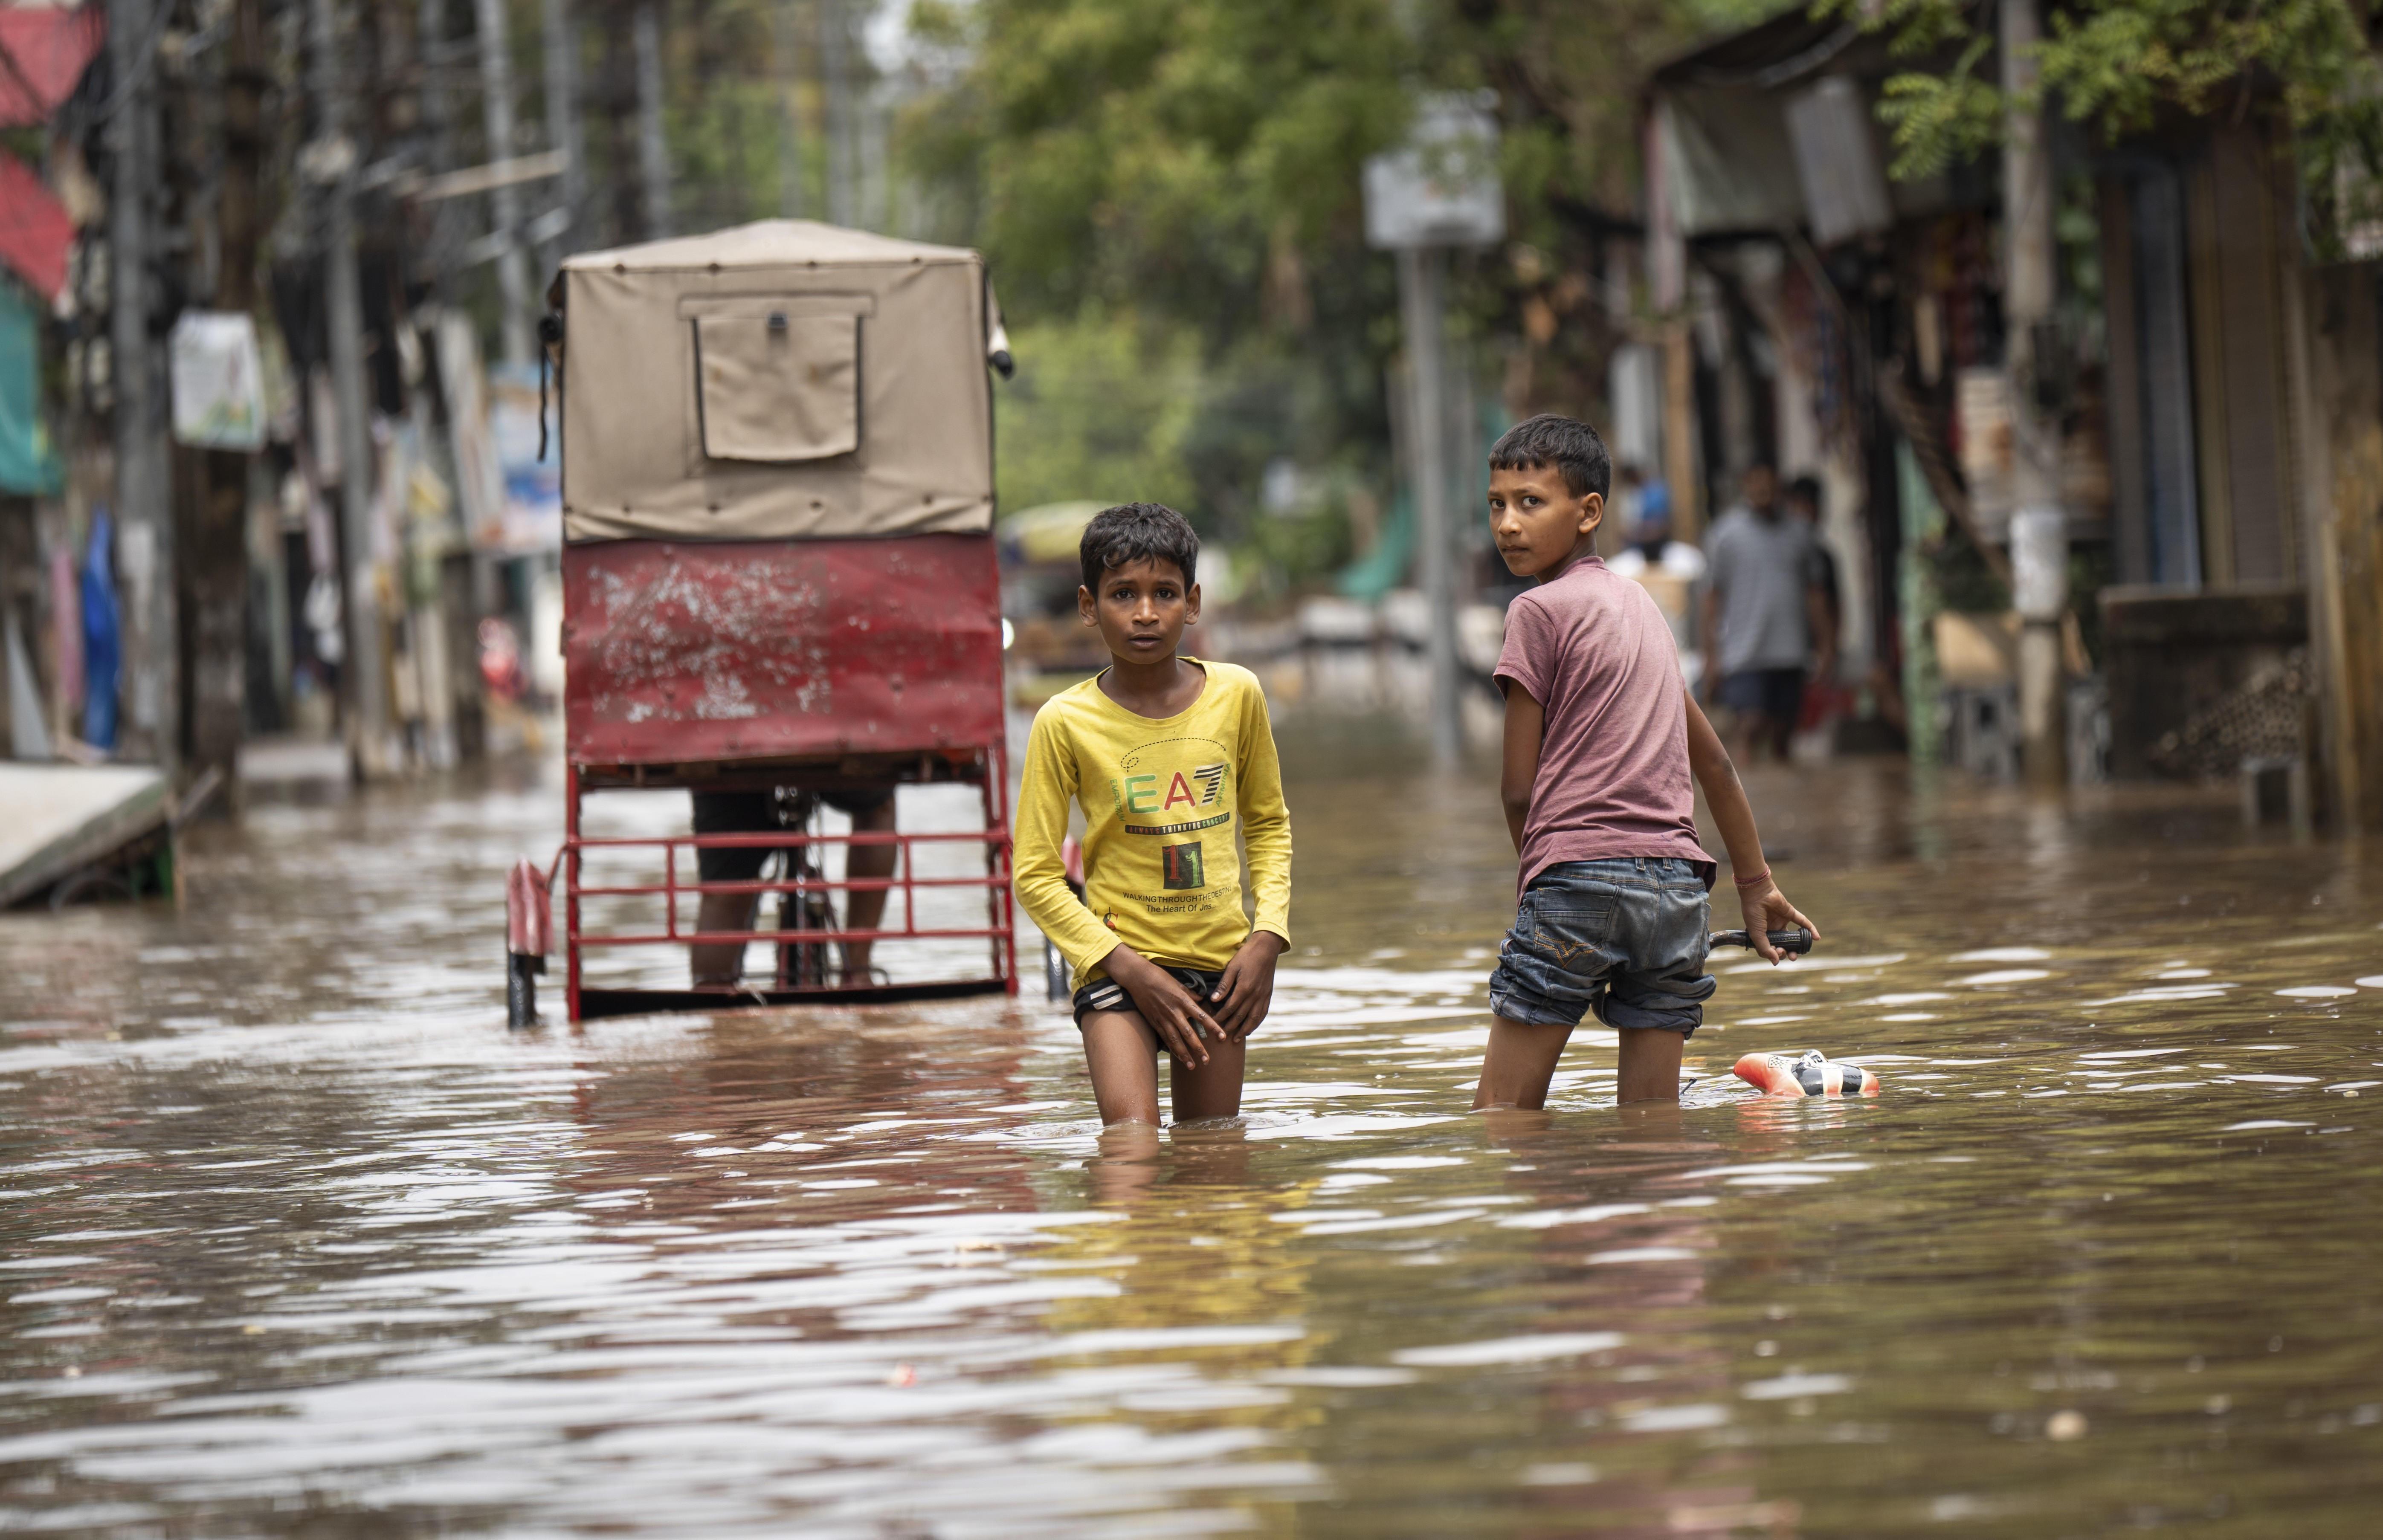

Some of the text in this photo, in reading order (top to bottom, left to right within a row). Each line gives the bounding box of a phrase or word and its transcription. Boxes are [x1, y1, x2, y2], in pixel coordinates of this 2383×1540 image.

[1110, 779, 1126, 821] EMPORIUM
[1124, 761, 1225, 814] EA7
[1129, 813, 1229, 834] ALWAYS THINKING CONCEPT
[1146, 904, 1161, 912] The
[1188, 903, 1197, 912] Of
